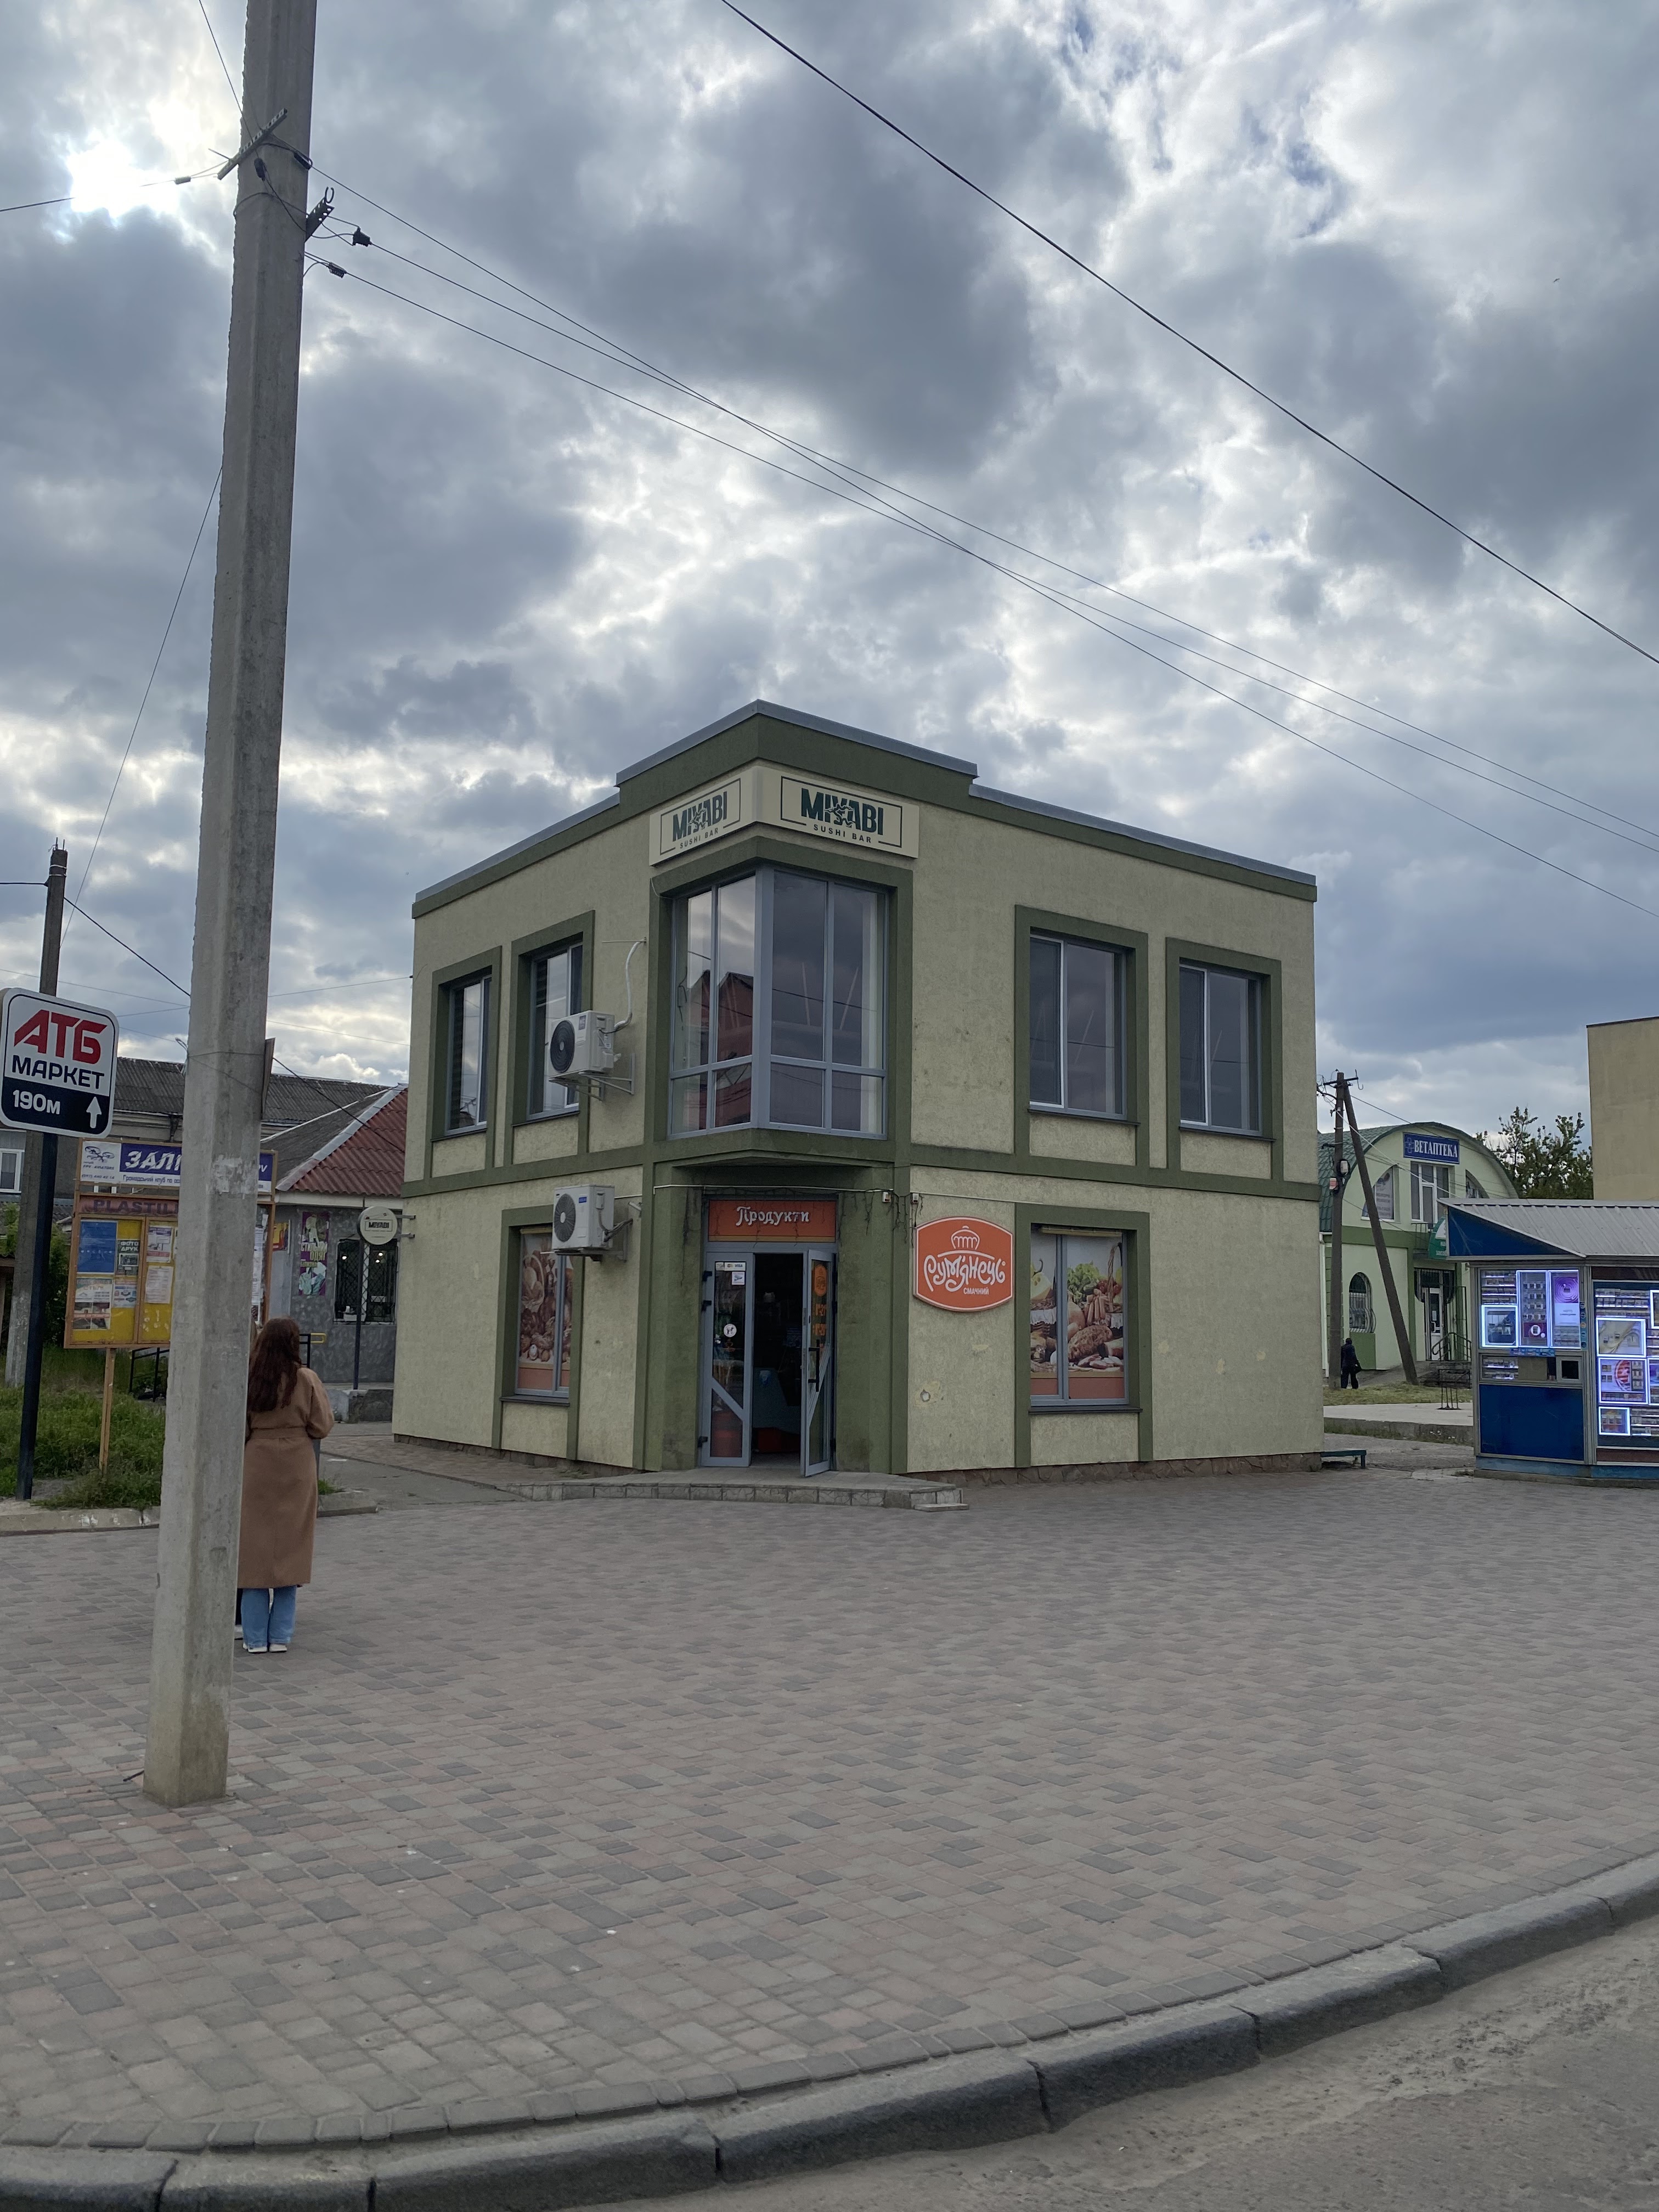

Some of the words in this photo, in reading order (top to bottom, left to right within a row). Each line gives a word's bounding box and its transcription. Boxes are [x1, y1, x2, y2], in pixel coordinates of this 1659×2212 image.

[673, 791, 727, 842] MIYABI
[800, 788, 884, 836] MIYABI
[680, 835, 701, 849] SUSHI
[704, 827, 719, 839] BAR
[813, 824, 845, 837] SUSHI
[852, 833, 871, 843] BAR
[14, 1009, 108, 1064] АТБ
[12, 1055, 105, 1090] МАРКЕТ
[1414, 1139, 1458, 1158] ВЕТАПТЕКА
[736, 1206, 810, 1226] Продукти
[963, 1287, 989, 1295] СМАЧНИЙ
